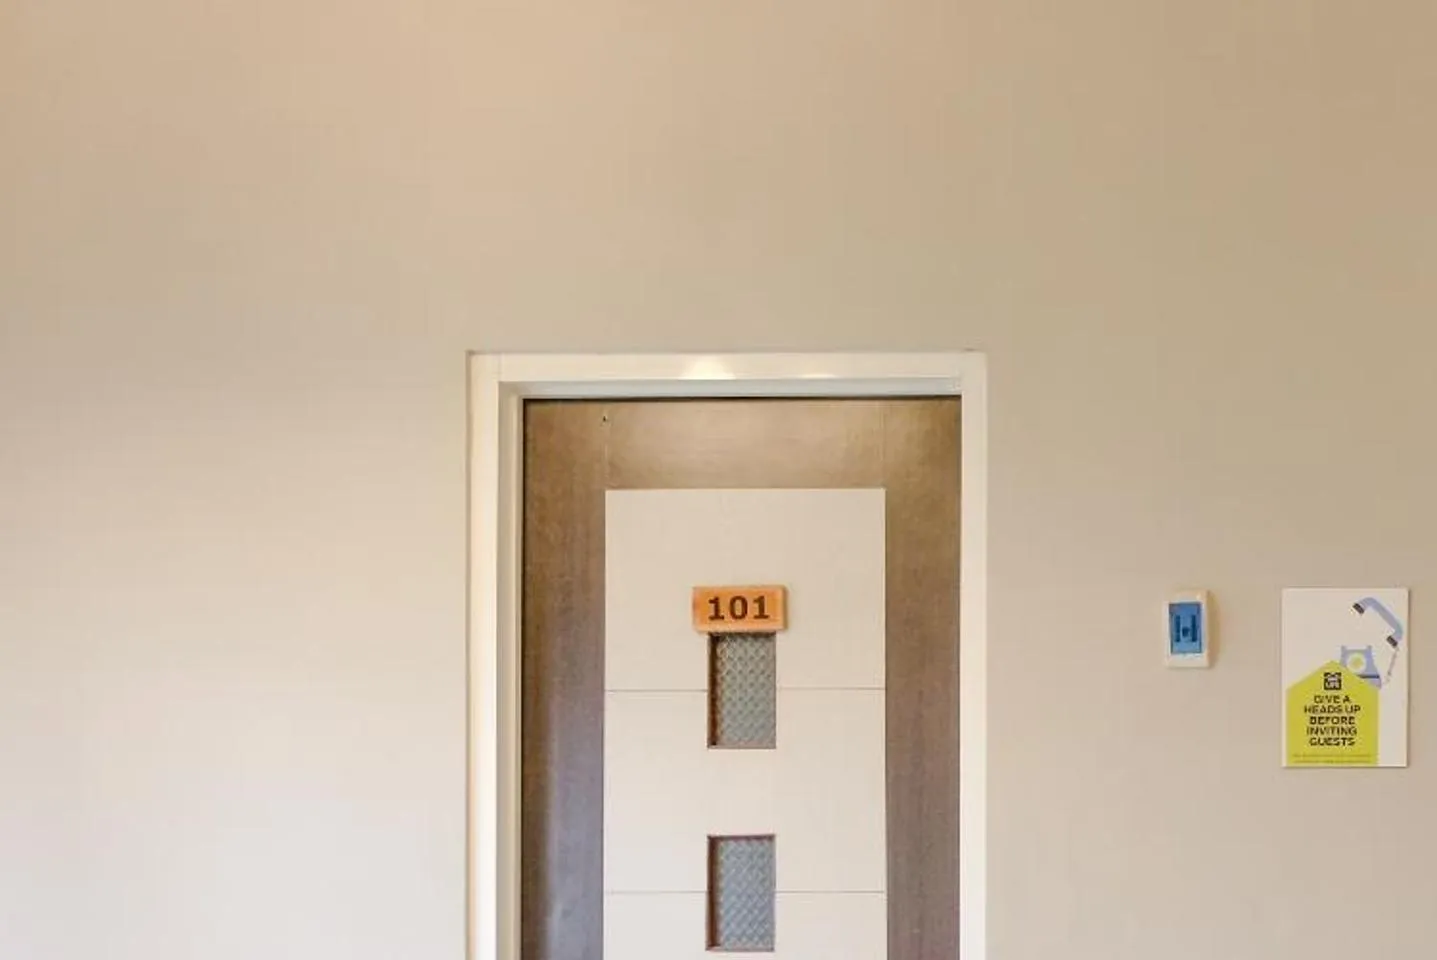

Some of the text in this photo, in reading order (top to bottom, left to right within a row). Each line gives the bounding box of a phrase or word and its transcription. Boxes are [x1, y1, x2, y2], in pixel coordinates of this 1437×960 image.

[708, 595, 770, 621] 101
[1313, 695, 1351, 704] GIVE A
[1304, 704, 1361, 714] HEADS UP
[1309, 715, 1355, 725] BEFORE
[1306, 725, 1358, 736] INVITING
[1309, 737, 1355, 746] GUESTS
